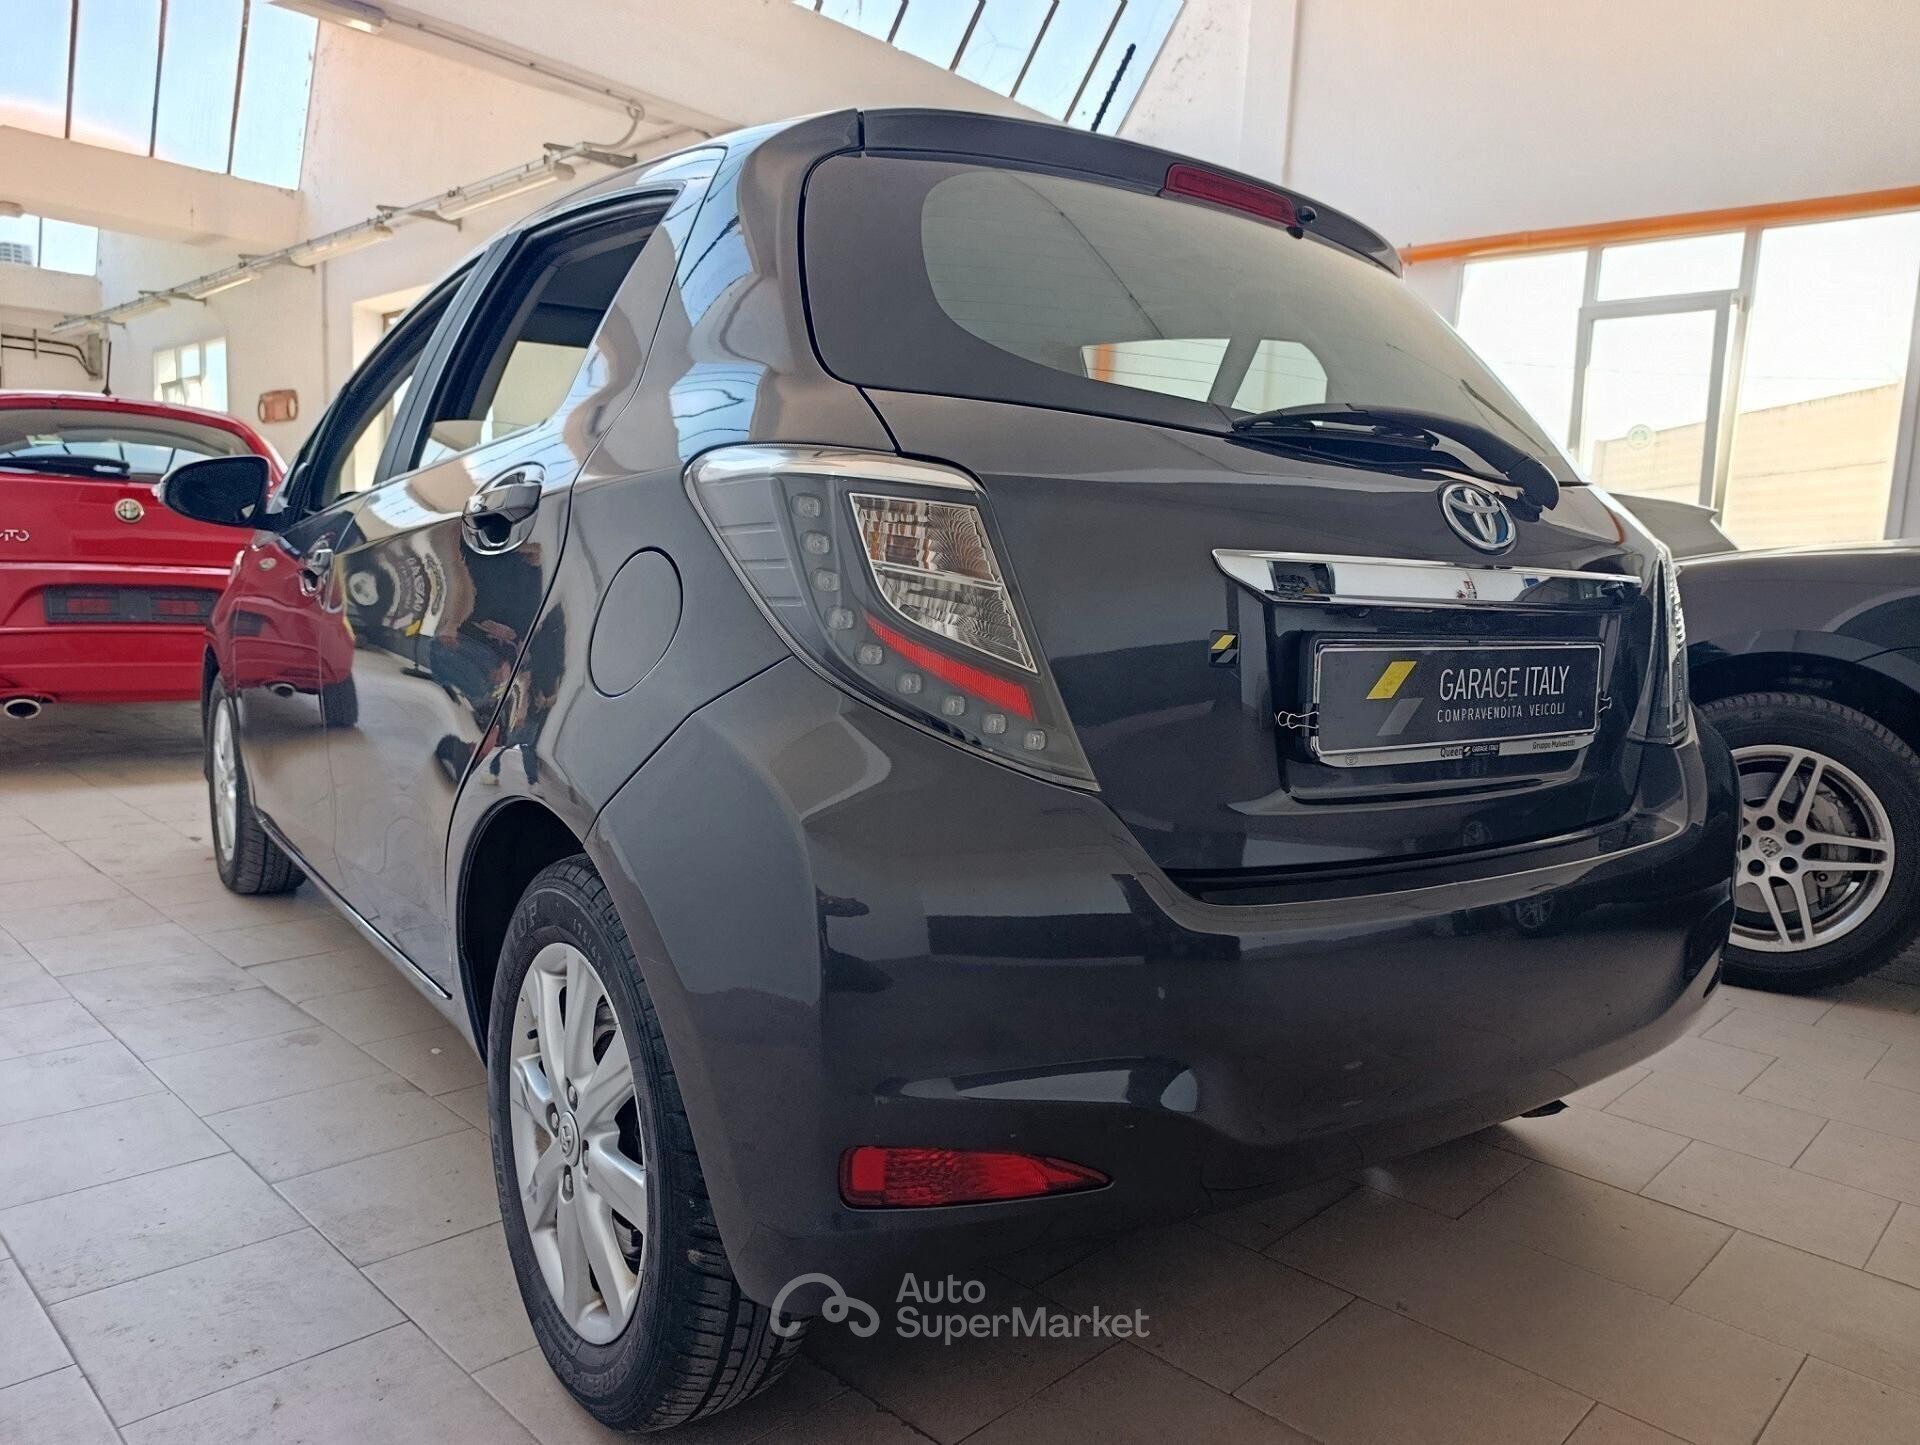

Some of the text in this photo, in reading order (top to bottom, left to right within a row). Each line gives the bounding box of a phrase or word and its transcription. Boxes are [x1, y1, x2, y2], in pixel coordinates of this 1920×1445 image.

[1439, 665, 1570, 701] GARAGE ITALY
[1437, 702, 1565, 723] COMPRAVENDITA VEICOLI
